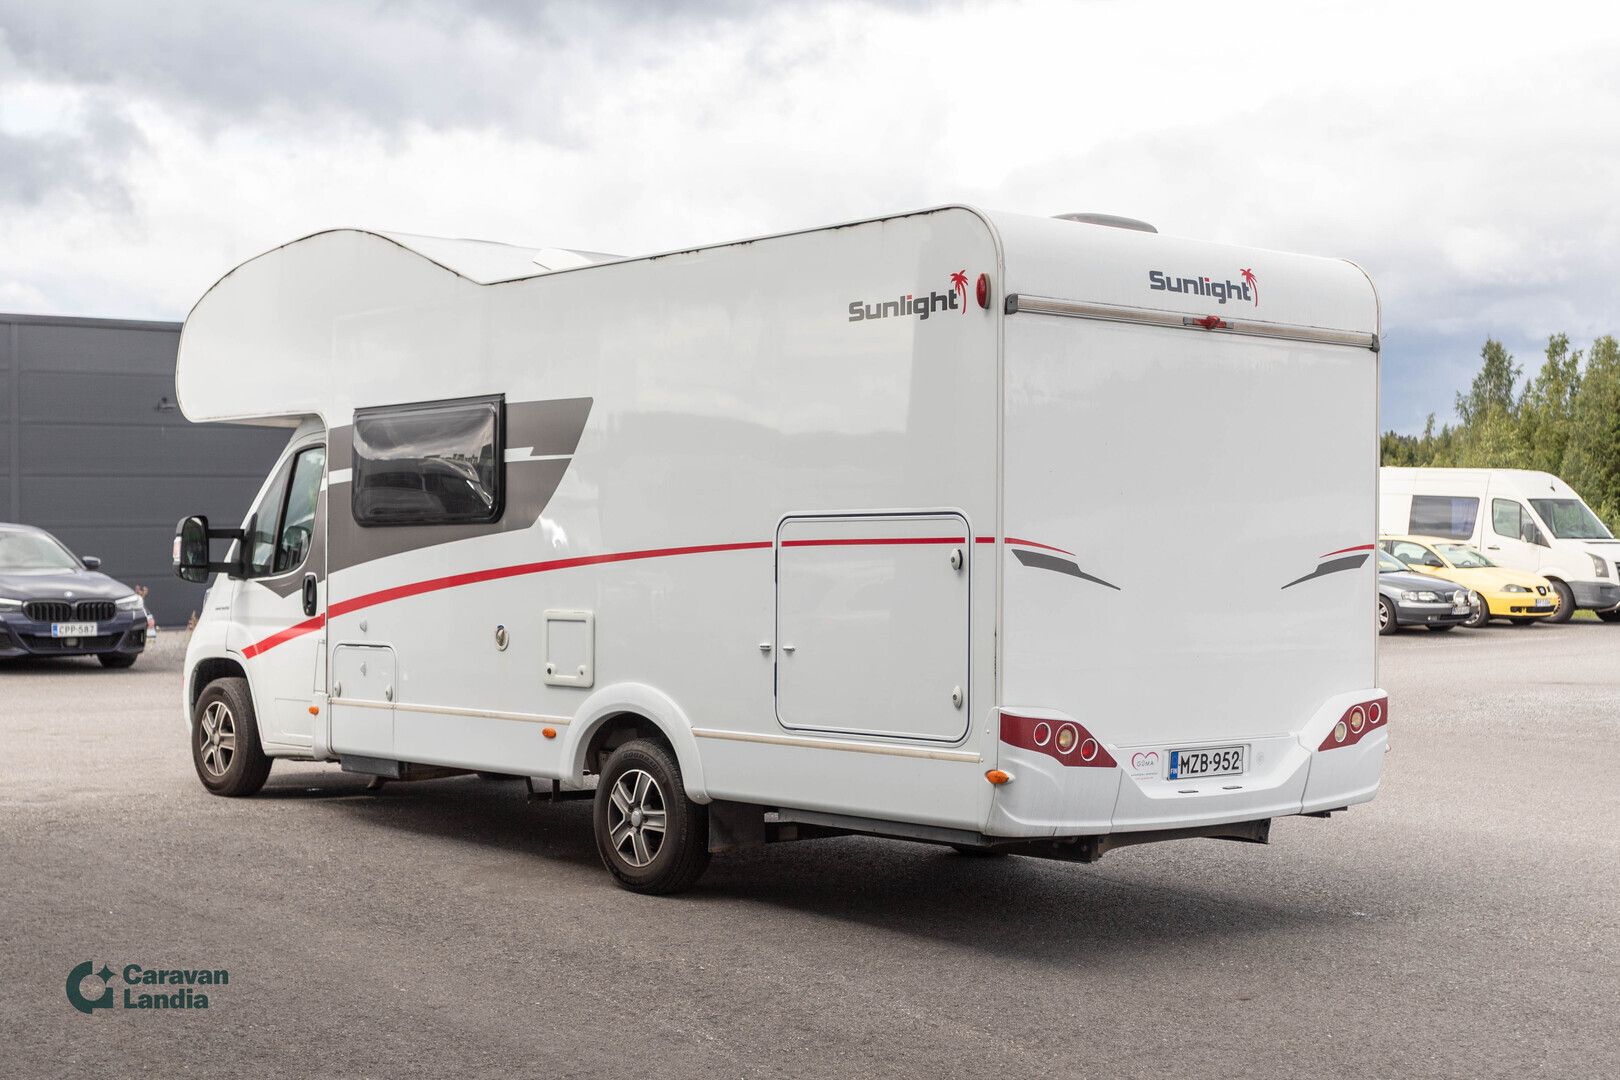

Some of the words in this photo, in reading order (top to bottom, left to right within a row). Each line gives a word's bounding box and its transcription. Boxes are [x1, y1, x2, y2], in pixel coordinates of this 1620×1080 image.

[1149, 270, 1251, 304] Sunlight
[849, 289, 958, 321] Sunlight
[1180, 751, 1240, 774] MZB-952
